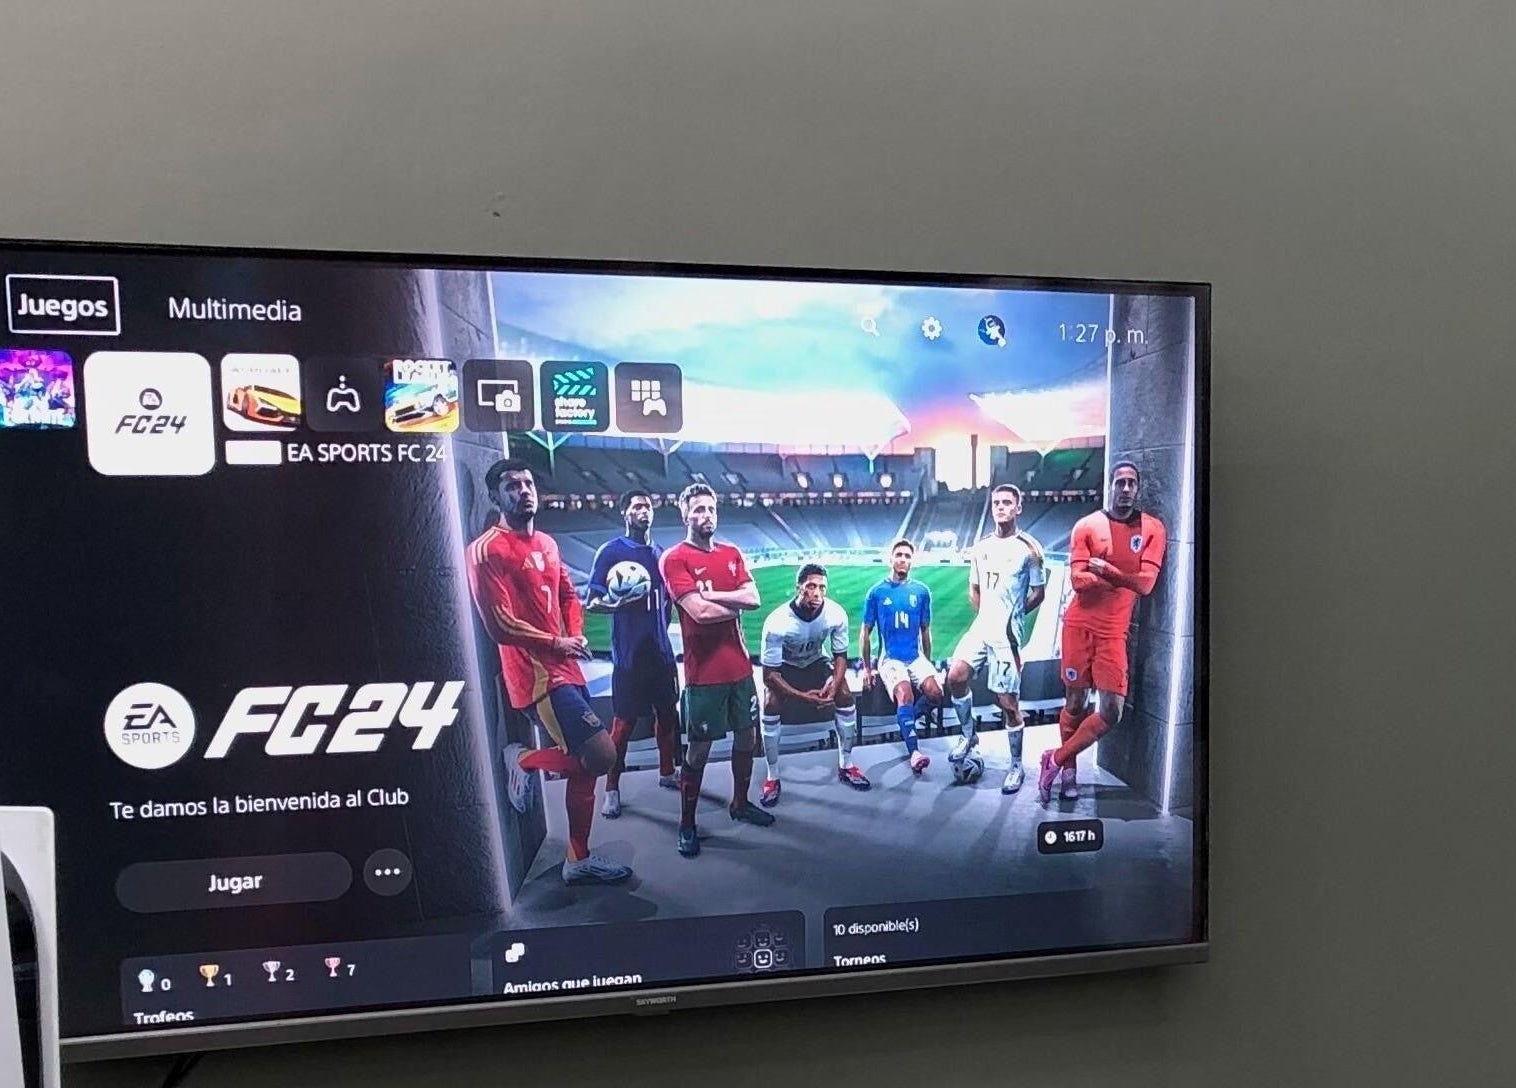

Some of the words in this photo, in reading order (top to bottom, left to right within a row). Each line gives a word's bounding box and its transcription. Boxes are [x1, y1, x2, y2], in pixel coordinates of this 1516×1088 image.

[17, 293, 108, 320] Juegos
[168, 297, 302, 322] Multimedia
[1059, 323, 1098, 344] 1:27
[287, 444, 313, 462] EA
[318, 444, 393, 462] SPORTS
[397, 444, 421, 463] FC
[425, 444, 448, 463] 24
[985, 571, 1000, 591] 17
[123, 703, 177, 730] EA
[204, 681, 466, 759] FC24
[121, 731, 181, 746] SPORTS
[110, 802, 134, 820] Te
[139, 799, 206, 818] damos
[213, 796, 230, 814] la
[235, 791, 342, 813] bienvenida
[346, 789, 362, 807] al
[367, 787, 409, 806] Club
[1088, 830, 1096, 841] h
[208, 875, 262, 894] Jugar
[833, 924, 846, 936] 10
[848, 917, 920, 938] disponible(s)
[833, 953, 887, 967] Torneos
[224, 974, 232, 986] 1
[286, 969, 295, 981] 2
[347, 965, 356, 977] 7
[161, 978, 171, 991] 0
[503, 978, 559, 995] Amigos
[592, 973, 642, 988] juegan
[133, 1010, 195, 1025] Trofeos
